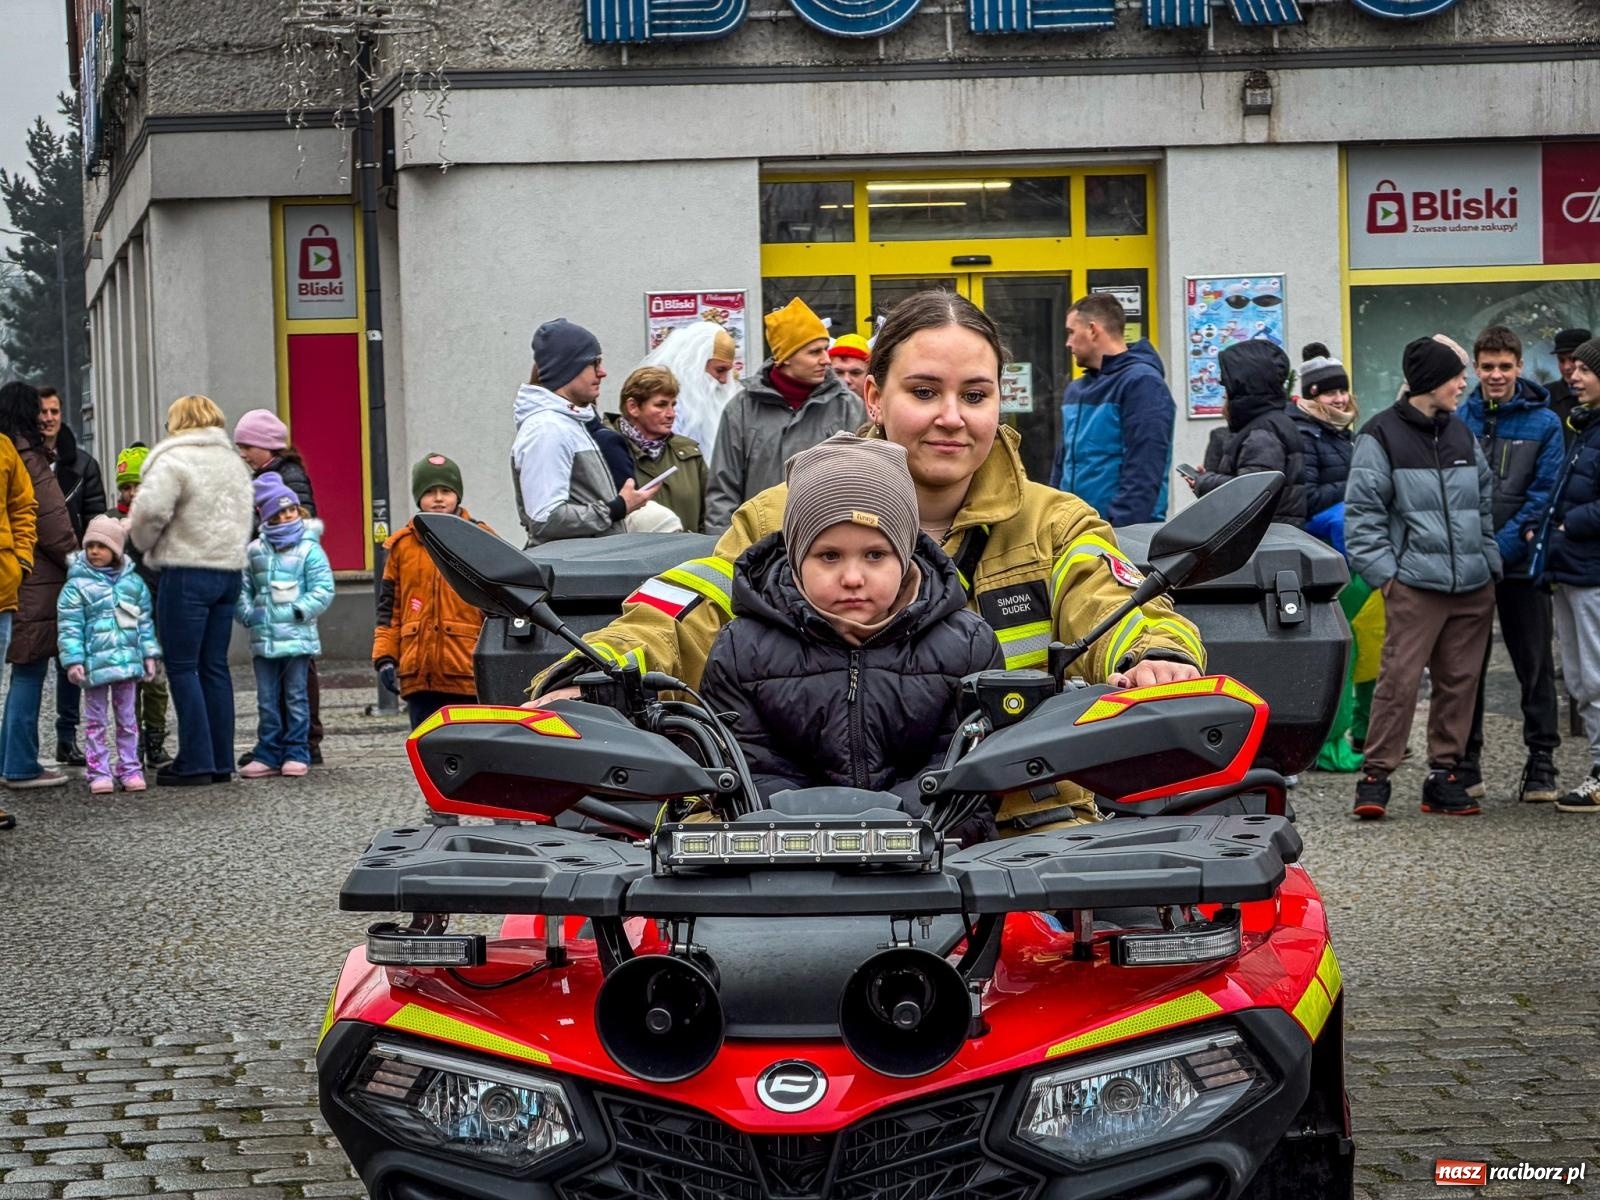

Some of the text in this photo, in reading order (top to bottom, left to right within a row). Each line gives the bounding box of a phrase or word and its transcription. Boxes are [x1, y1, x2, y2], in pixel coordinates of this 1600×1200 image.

[1412, 187, 1518, 221] Bliski
[1412, 222, 1518, 233] Zawsze udane zakupy!
[298, 281, 344, 296] Bliski
[664, 299, 695, 309] Bliski
[997, 593, 1031, 607] SIMONA
[1002, 603, 1031, 616] DUDEK
